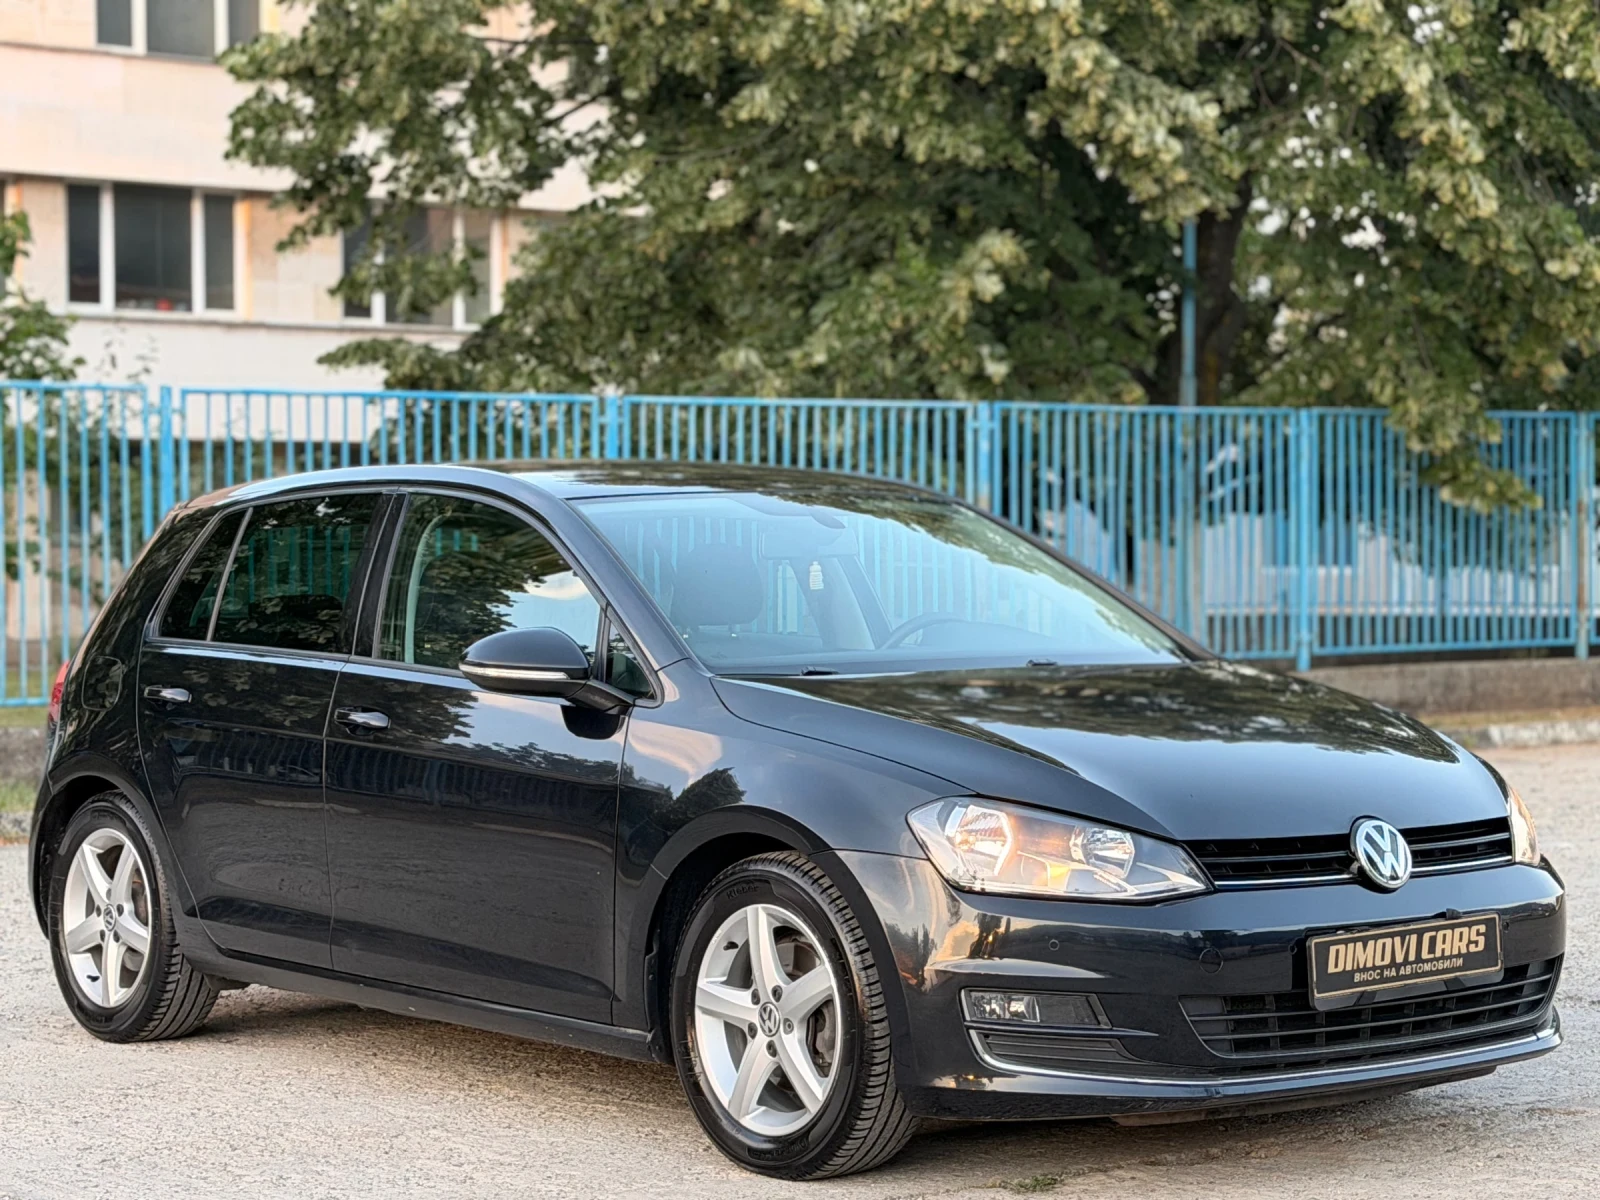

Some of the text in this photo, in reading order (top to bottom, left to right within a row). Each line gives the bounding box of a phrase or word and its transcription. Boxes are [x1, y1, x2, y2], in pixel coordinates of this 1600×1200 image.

[1356, 820, 1411, 886] VW
[1327, 924, 1486, 974] DIMOVI CARS
[1353, 957, 1463, 983] ВНОС НА АВТОМОБИЛИ
